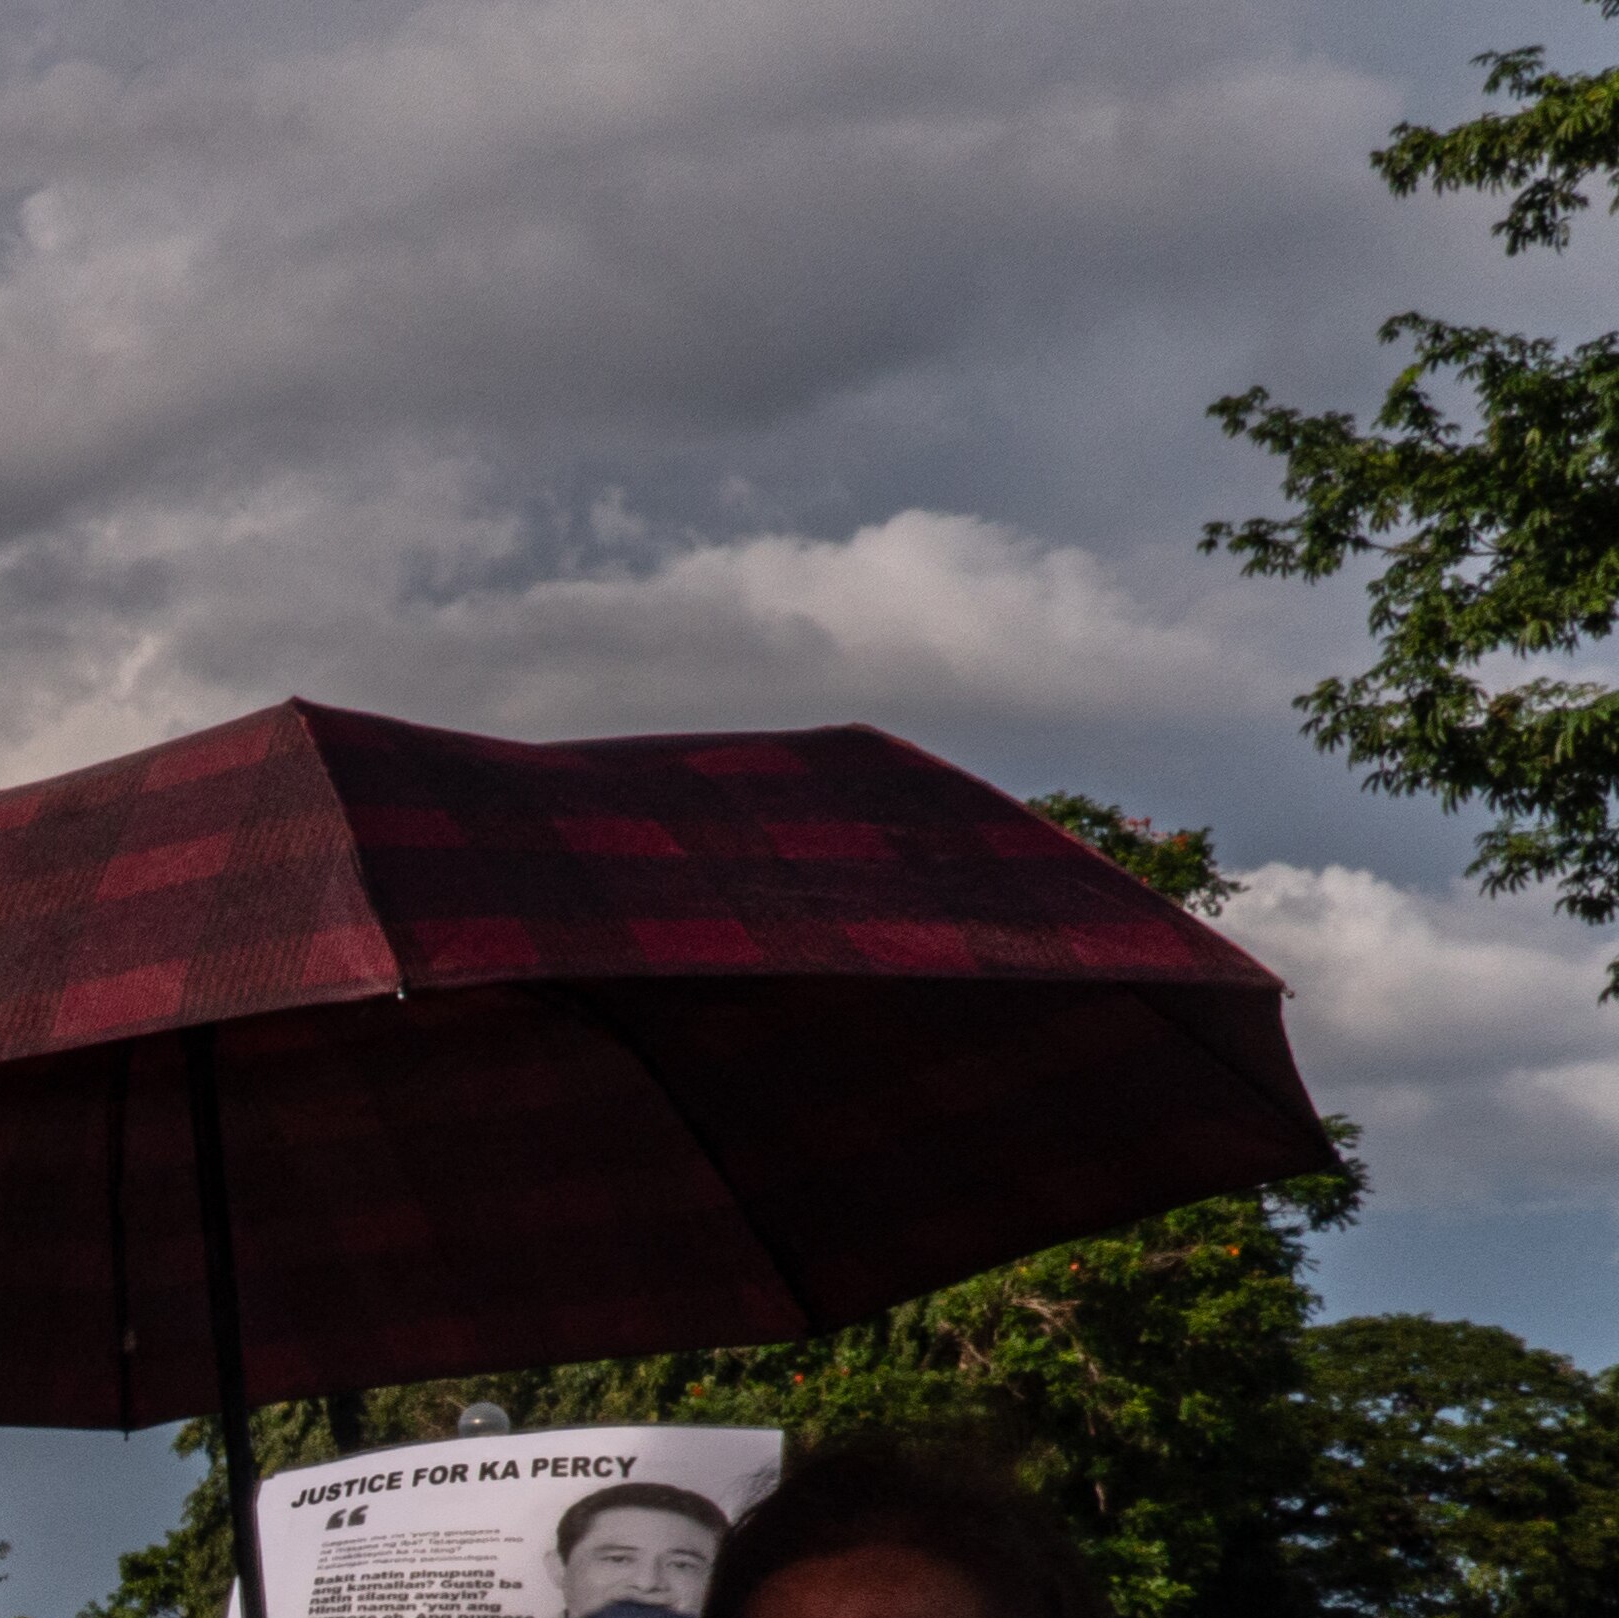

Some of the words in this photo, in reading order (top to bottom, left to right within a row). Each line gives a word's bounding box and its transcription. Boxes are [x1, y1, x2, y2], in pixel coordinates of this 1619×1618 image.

[291, 1471, 404, 1508] JUSTICE
[412, 1463, 469, 1488] FOR
[478, 1461, 520, 1482] KA
[531, 1456, 638, 1479] PERCY
